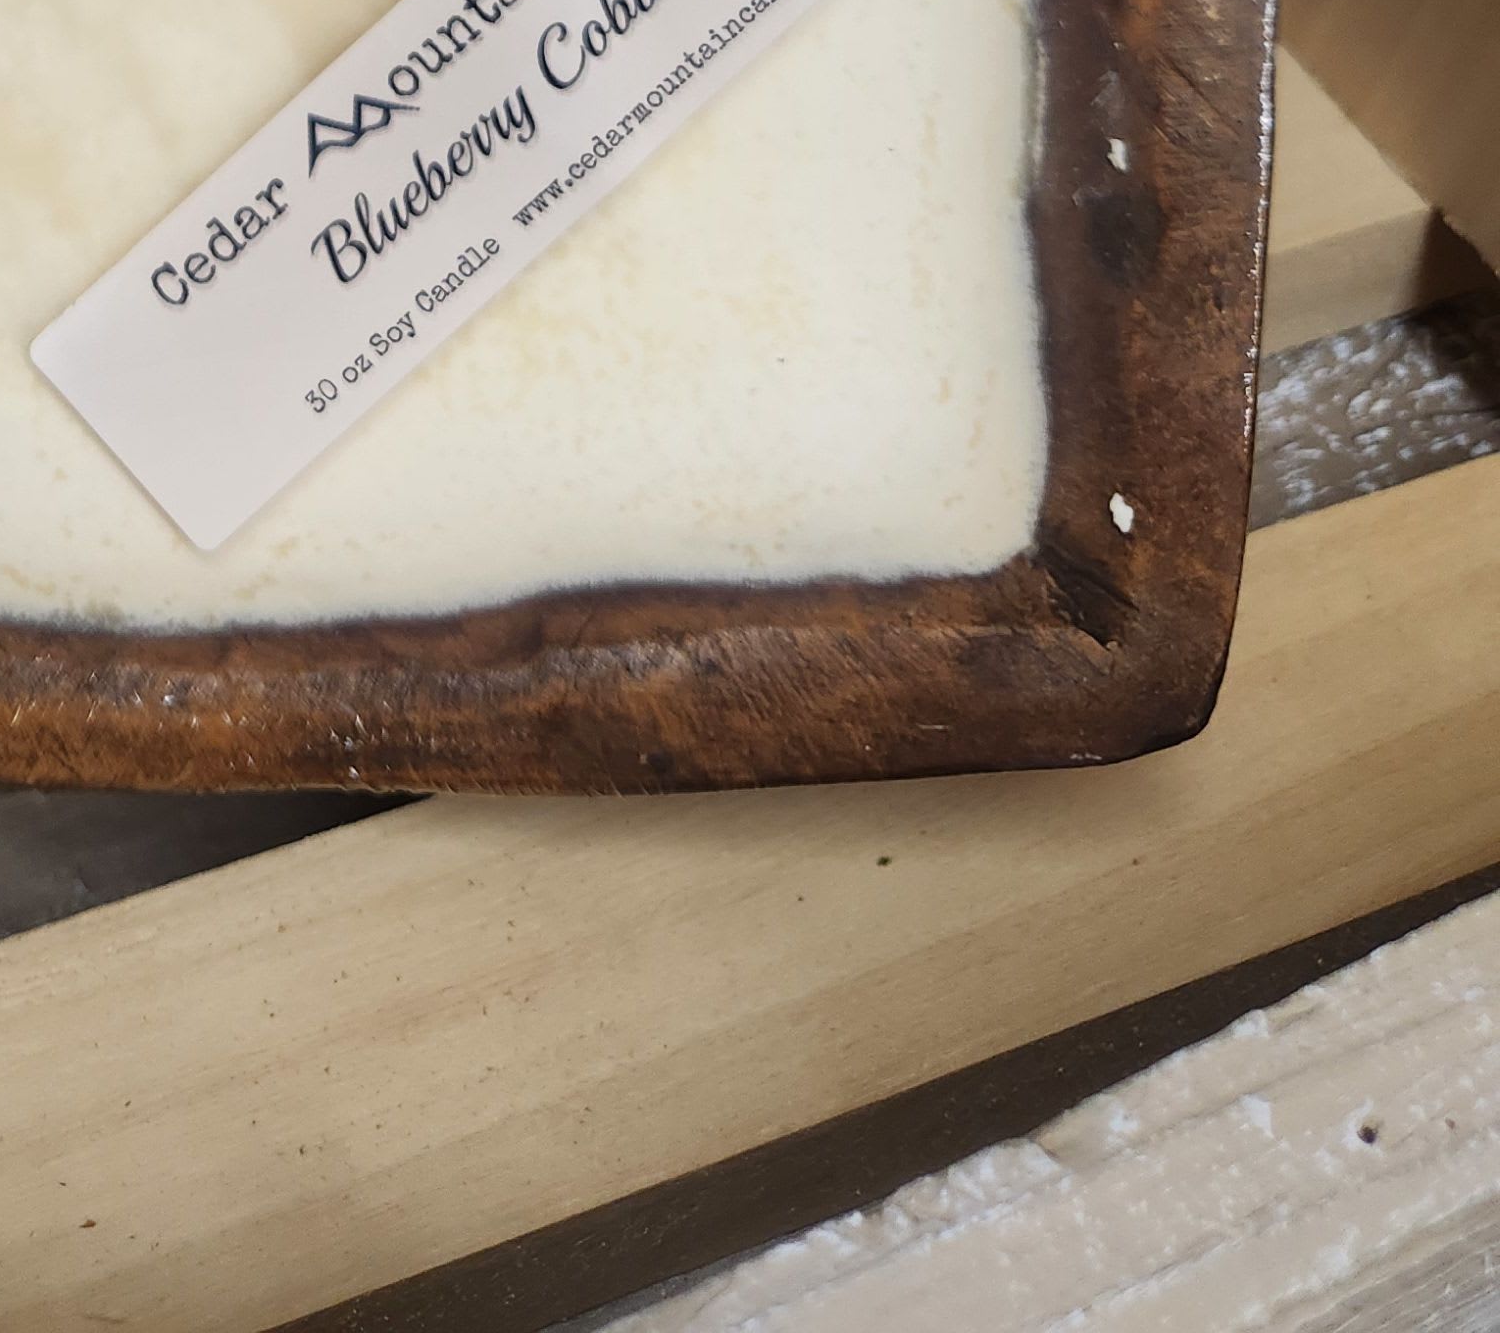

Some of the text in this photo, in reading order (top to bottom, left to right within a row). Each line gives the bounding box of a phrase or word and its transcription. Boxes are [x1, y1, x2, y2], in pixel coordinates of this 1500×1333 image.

[150, 177, 289, 306] Cedar
[310, 84, 537, 283] Blueberry
[304, 378, 339, 414] 30
[341, 353, 374, 384] oz
[368, 310, 417, 357] Soy
[414, 237, 501, 313] Candle
